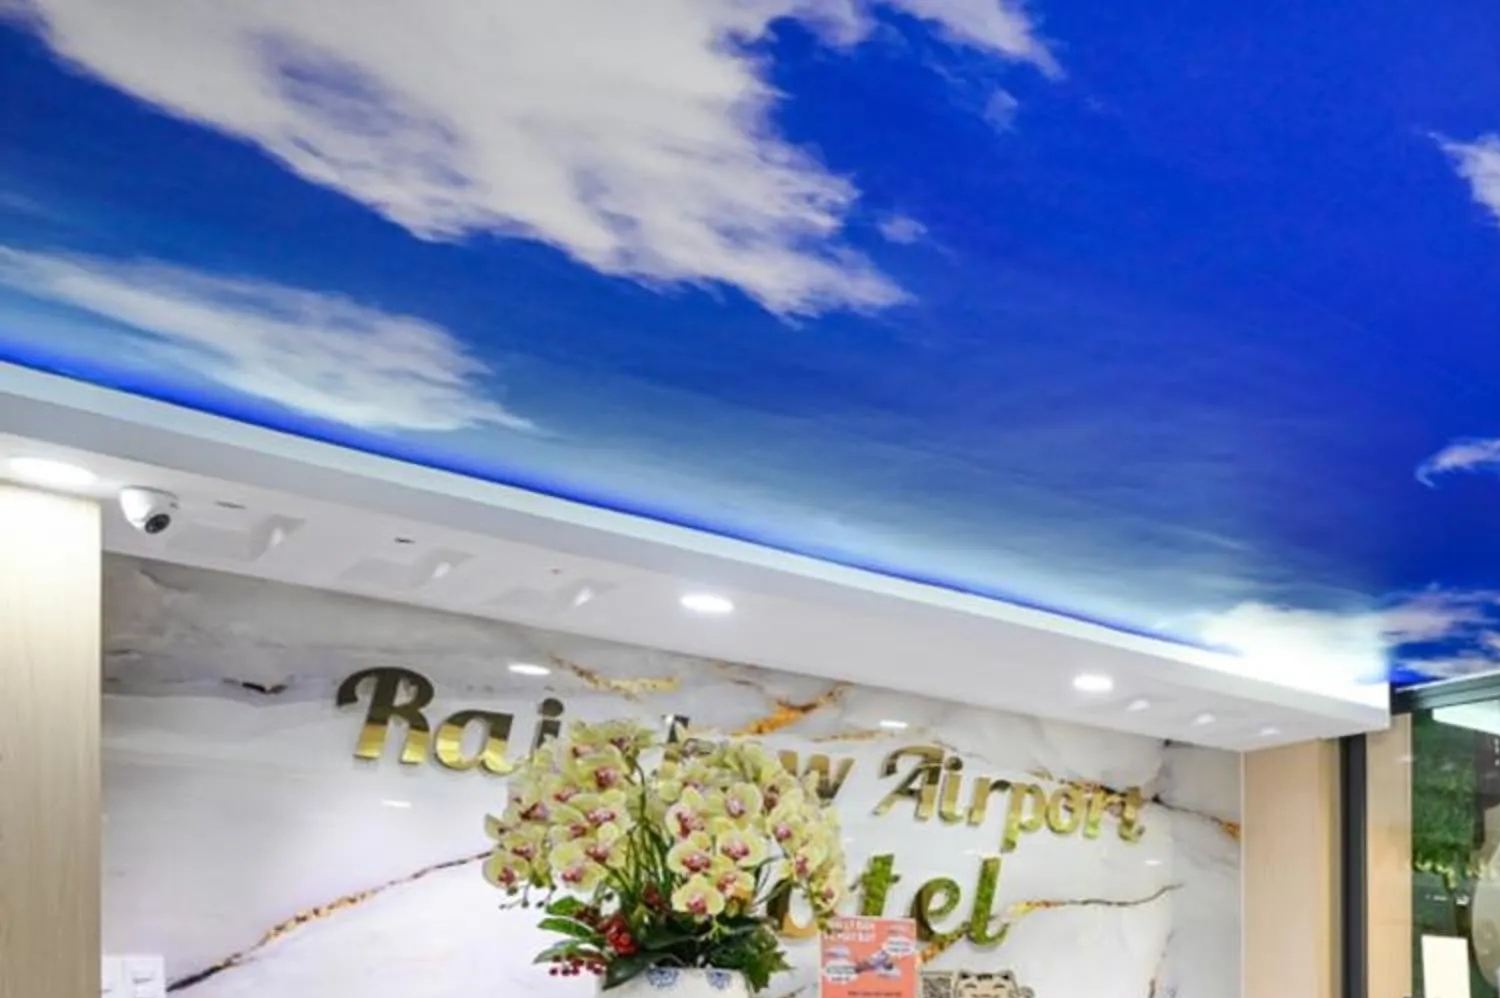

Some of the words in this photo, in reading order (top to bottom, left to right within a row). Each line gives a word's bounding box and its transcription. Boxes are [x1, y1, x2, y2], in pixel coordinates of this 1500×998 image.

[336, 667, 855, 800] Raiw
[872, 745, 1147, 853] Airport
[767, 854, 1010, 947] otel
